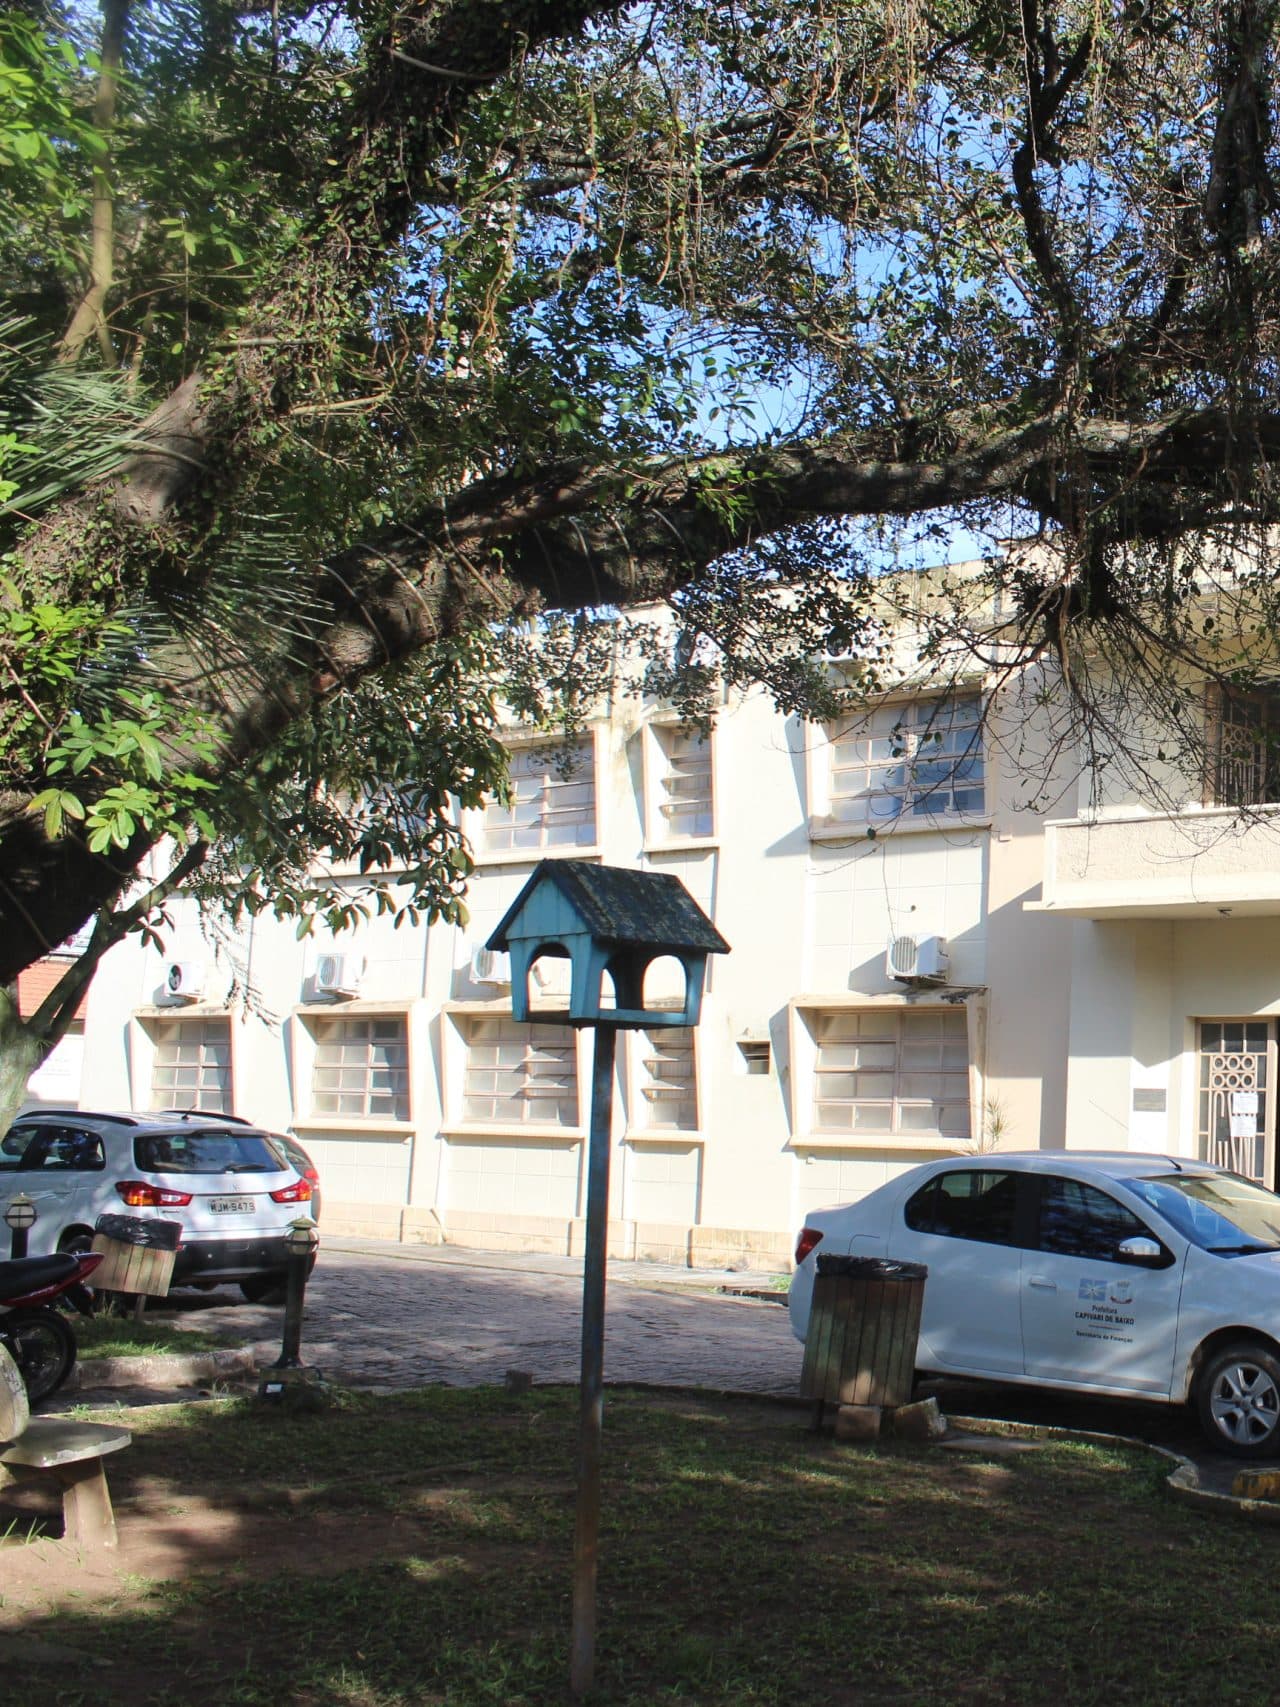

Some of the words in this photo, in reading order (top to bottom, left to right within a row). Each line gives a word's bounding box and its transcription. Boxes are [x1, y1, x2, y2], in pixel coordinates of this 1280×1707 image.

[1075, 1311, 1104, 1321] CAPIVARI
[1104, 1315, 1114, 1323] DE
[1115, 1316, 1136, 1325] BAIXO
